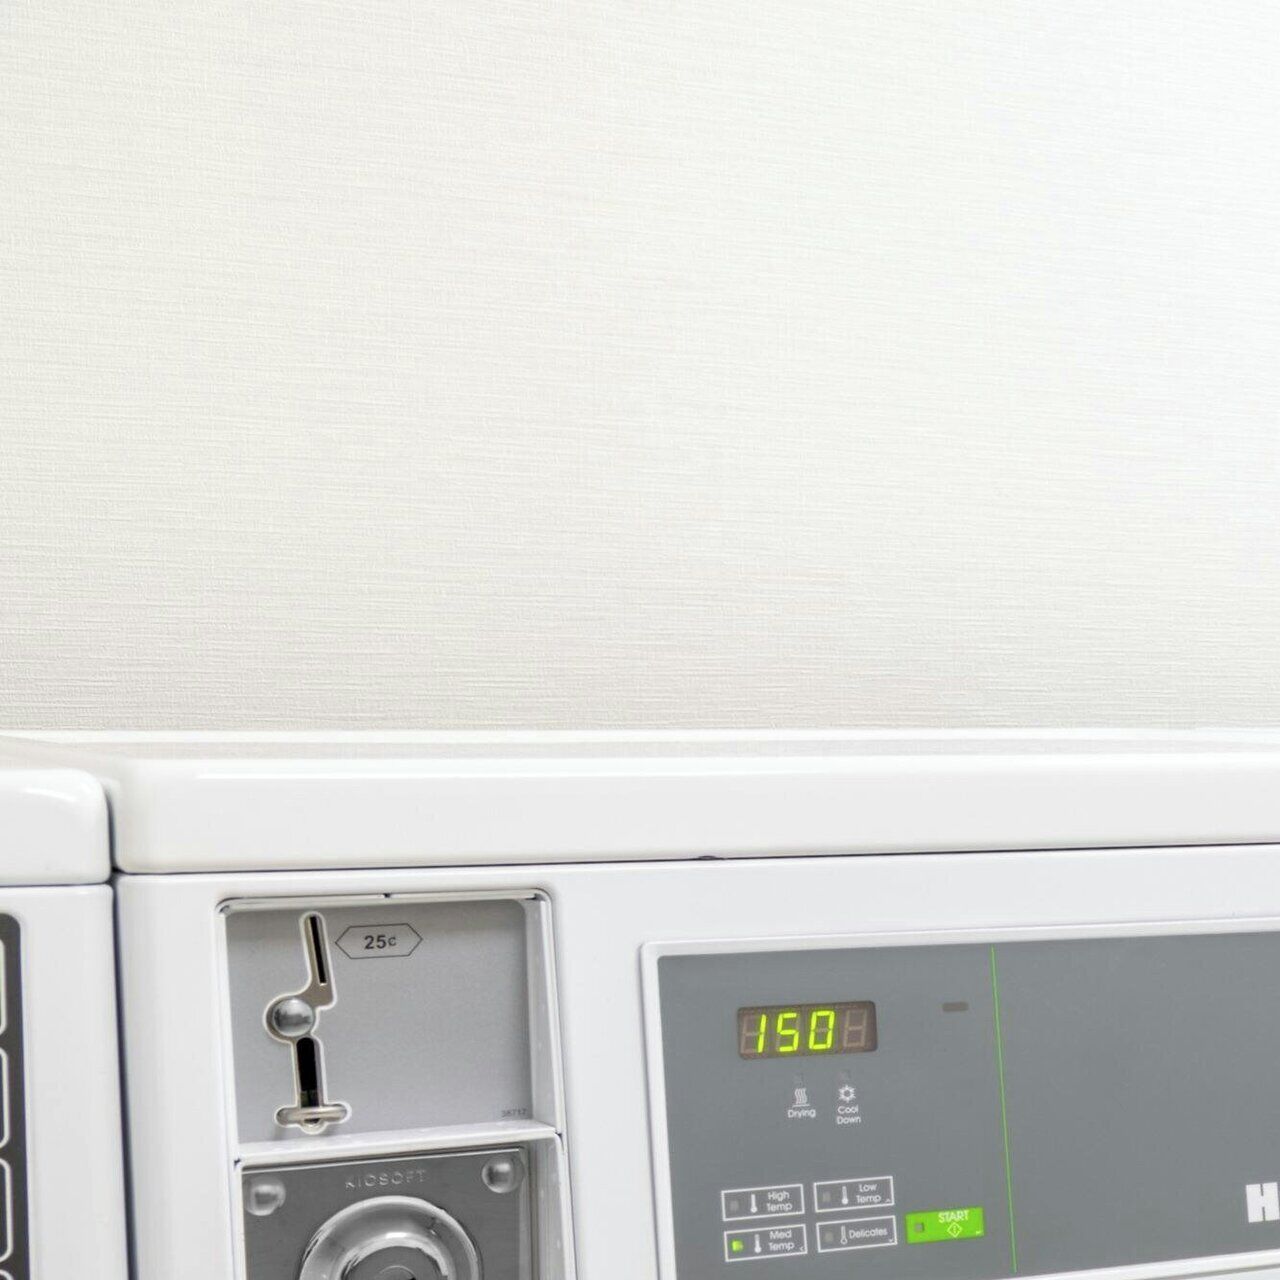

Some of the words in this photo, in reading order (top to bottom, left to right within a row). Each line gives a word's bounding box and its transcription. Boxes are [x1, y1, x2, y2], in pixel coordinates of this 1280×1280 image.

[757, 1010, 835, 1053] 150
[787, 1109, 816, 1119] Drying
[837, 1105, 859, 1114] Cool
[837, 1115, 861, 1125] Down
[858, 1183, 877, 1192] Low
[767, 1190, 790, 1202] High
[856, 1194, 882, 1205] Temp
[766, 1202, 793, 1213] Temp
[938, 1209, 969, 1223] START
[769, 1230, 792, 1240] Med
[848, 1226, 888, 1239] Delicates
[768, 1242, 795, 1253] Temp
